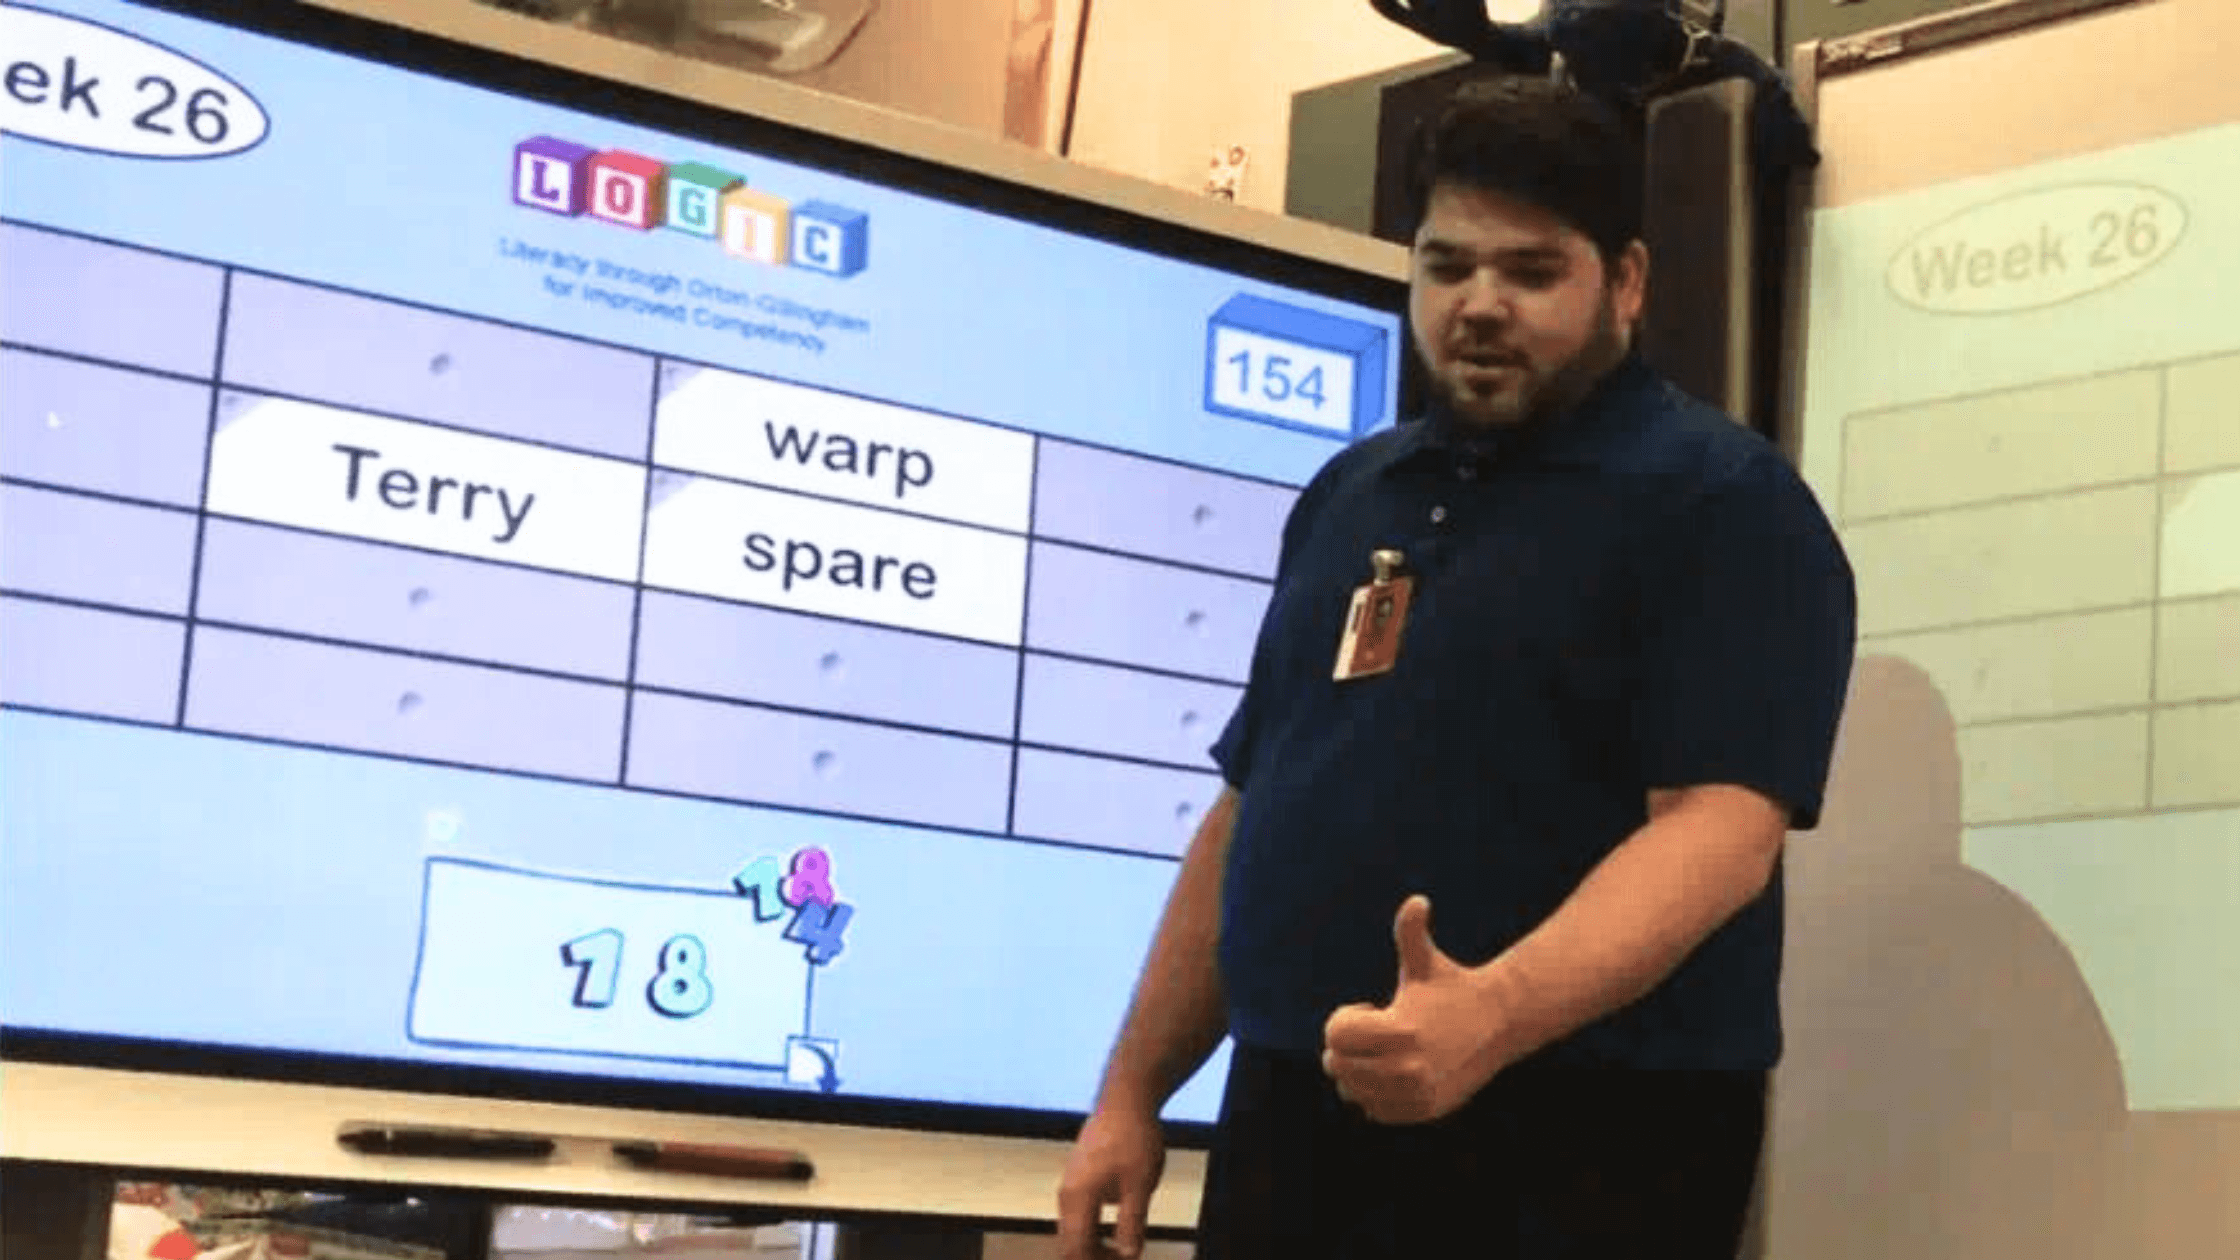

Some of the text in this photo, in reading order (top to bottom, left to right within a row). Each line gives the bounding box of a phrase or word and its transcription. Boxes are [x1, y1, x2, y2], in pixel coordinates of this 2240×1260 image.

[132, 75, 230, 144] 26
[532, 160, 830, 265] LOGIC
[1910, 203, 2160, 298] Week 26
[1228, 349, 1326, 410] 154
[332, 443, 535, 544] Terry
[765, 420, 934, 498] warp
[743, 530, 939, 600] spare
